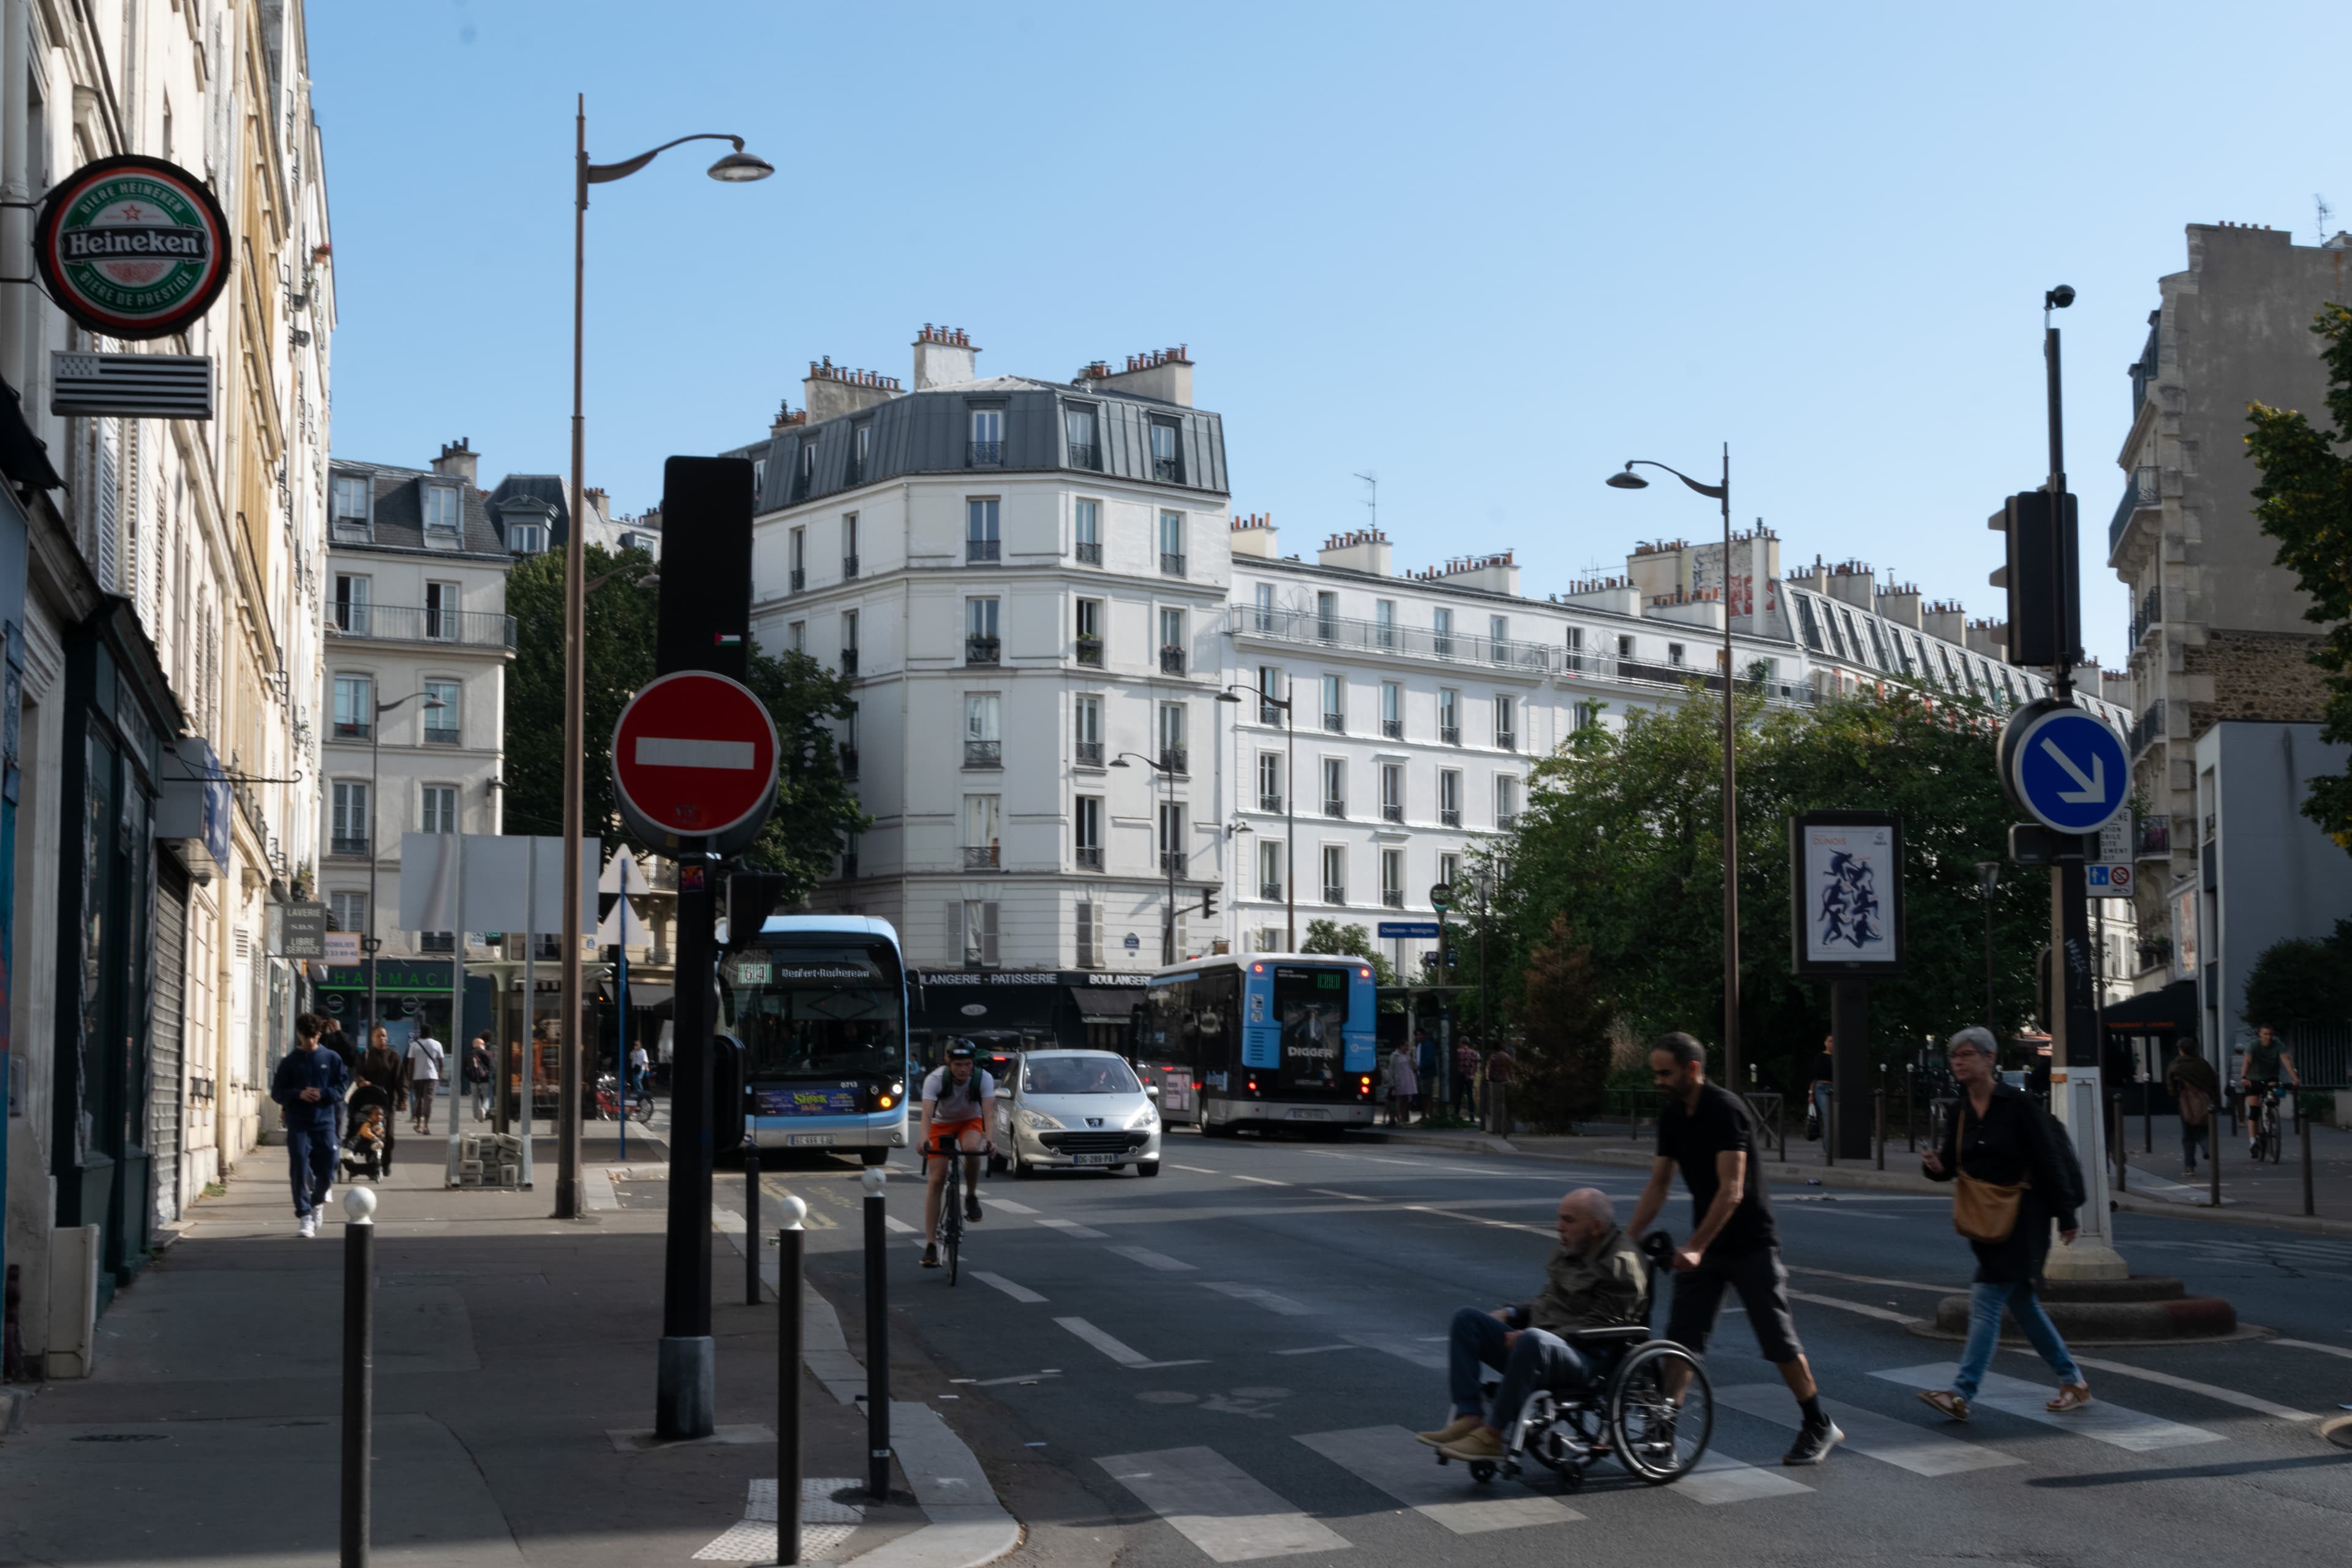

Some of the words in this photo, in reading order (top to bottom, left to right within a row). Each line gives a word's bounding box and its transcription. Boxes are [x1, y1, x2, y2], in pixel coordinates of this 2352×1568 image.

[80, 186, 116, 214] BIERE
[119, 183, 185, 213] HEINEKEN
[69, 230, 200, 255] Heineken
[78, 271, 115, 301] BIERE
[116, 292, 133, 306] DE
[137, 270, 193, 307] PRESTIGE
[287, 908, 322, 917] LAVERIE
[290, 937, 316, 946] LIBRE
[285, 946, 322, 955] SERVICE
[991, 973, 1058, 985] PATISSERIE
[1287, 1046, 1334, 1059] DIGGER
